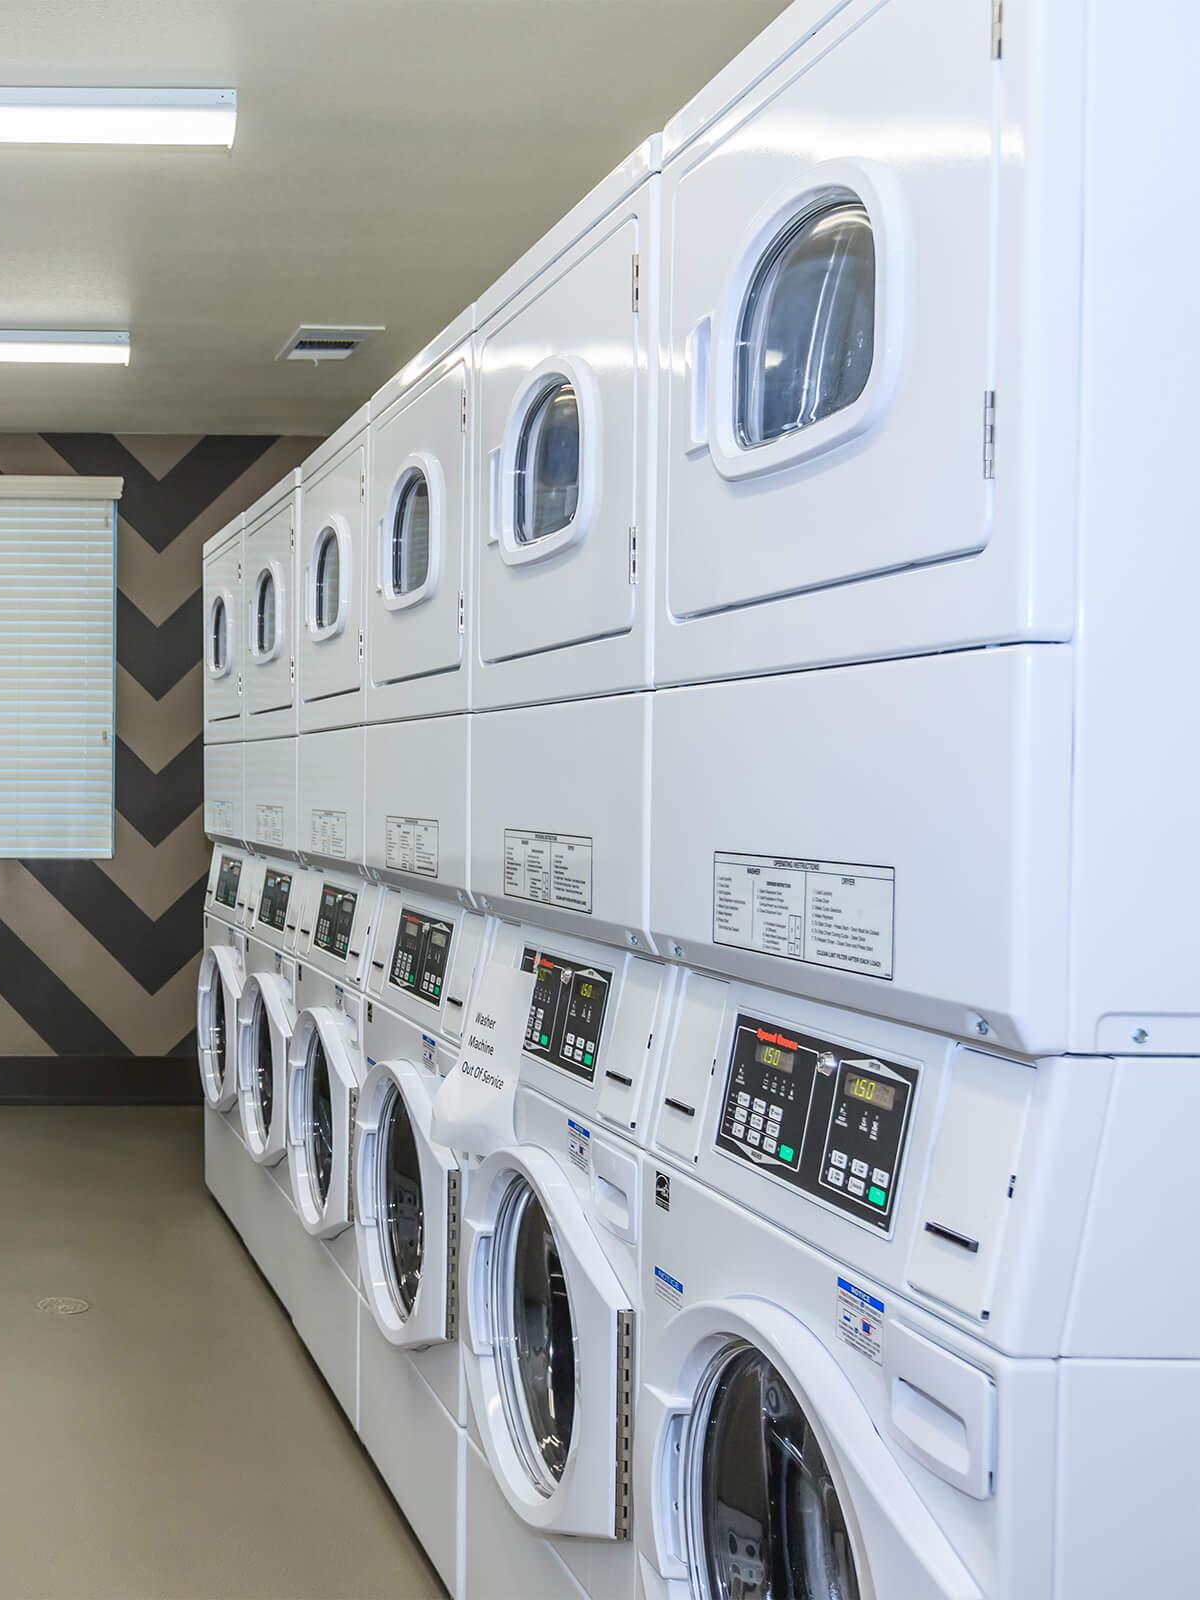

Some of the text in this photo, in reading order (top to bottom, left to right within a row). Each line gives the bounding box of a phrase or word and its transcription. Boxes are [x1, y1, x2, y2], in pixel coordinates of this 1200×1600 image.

[475, 1011, 497, 1030] Washer
[467, 1034, 495, 1056] Machine
[461, 1060, 505, 1090] Out Of Service
